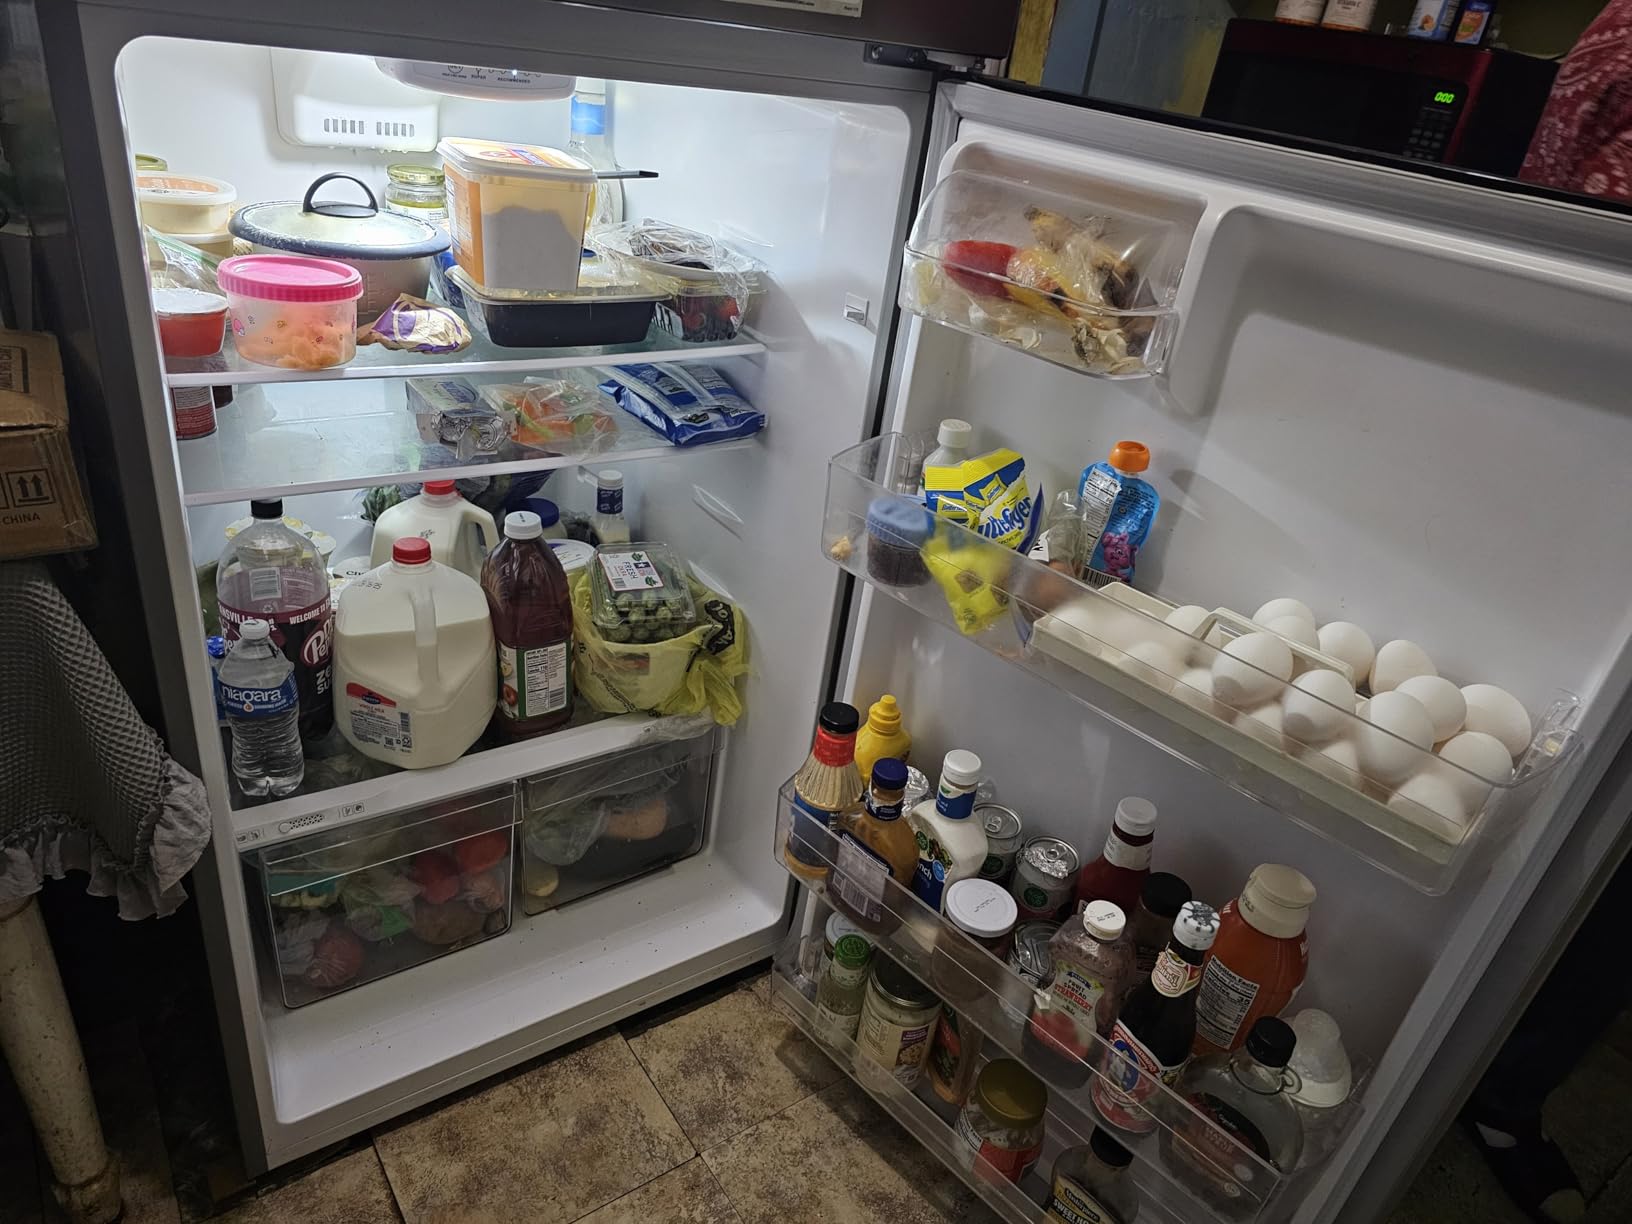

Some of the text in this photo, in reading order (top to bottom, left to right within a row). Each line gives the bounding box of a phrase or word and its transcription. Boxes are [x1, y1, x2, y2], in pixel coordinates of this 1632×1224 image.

[3, 511, 41, 525] CHINA
[289, 608, 320, 625] WELCOME
[304, 630, 331, 665] Pep
[316, 665, 332, 685] ze
[222, 685, 282, 706] niagara
[1212, 957, 1237, 981] Nutrition
[1238, 978, 1258, 990] Facts
[1063, 982, 1087, 1000] SPREAD
[1068, 979, 1085, 992] FRUIT
[1053, 1198, 1075, 1222] SWEET
